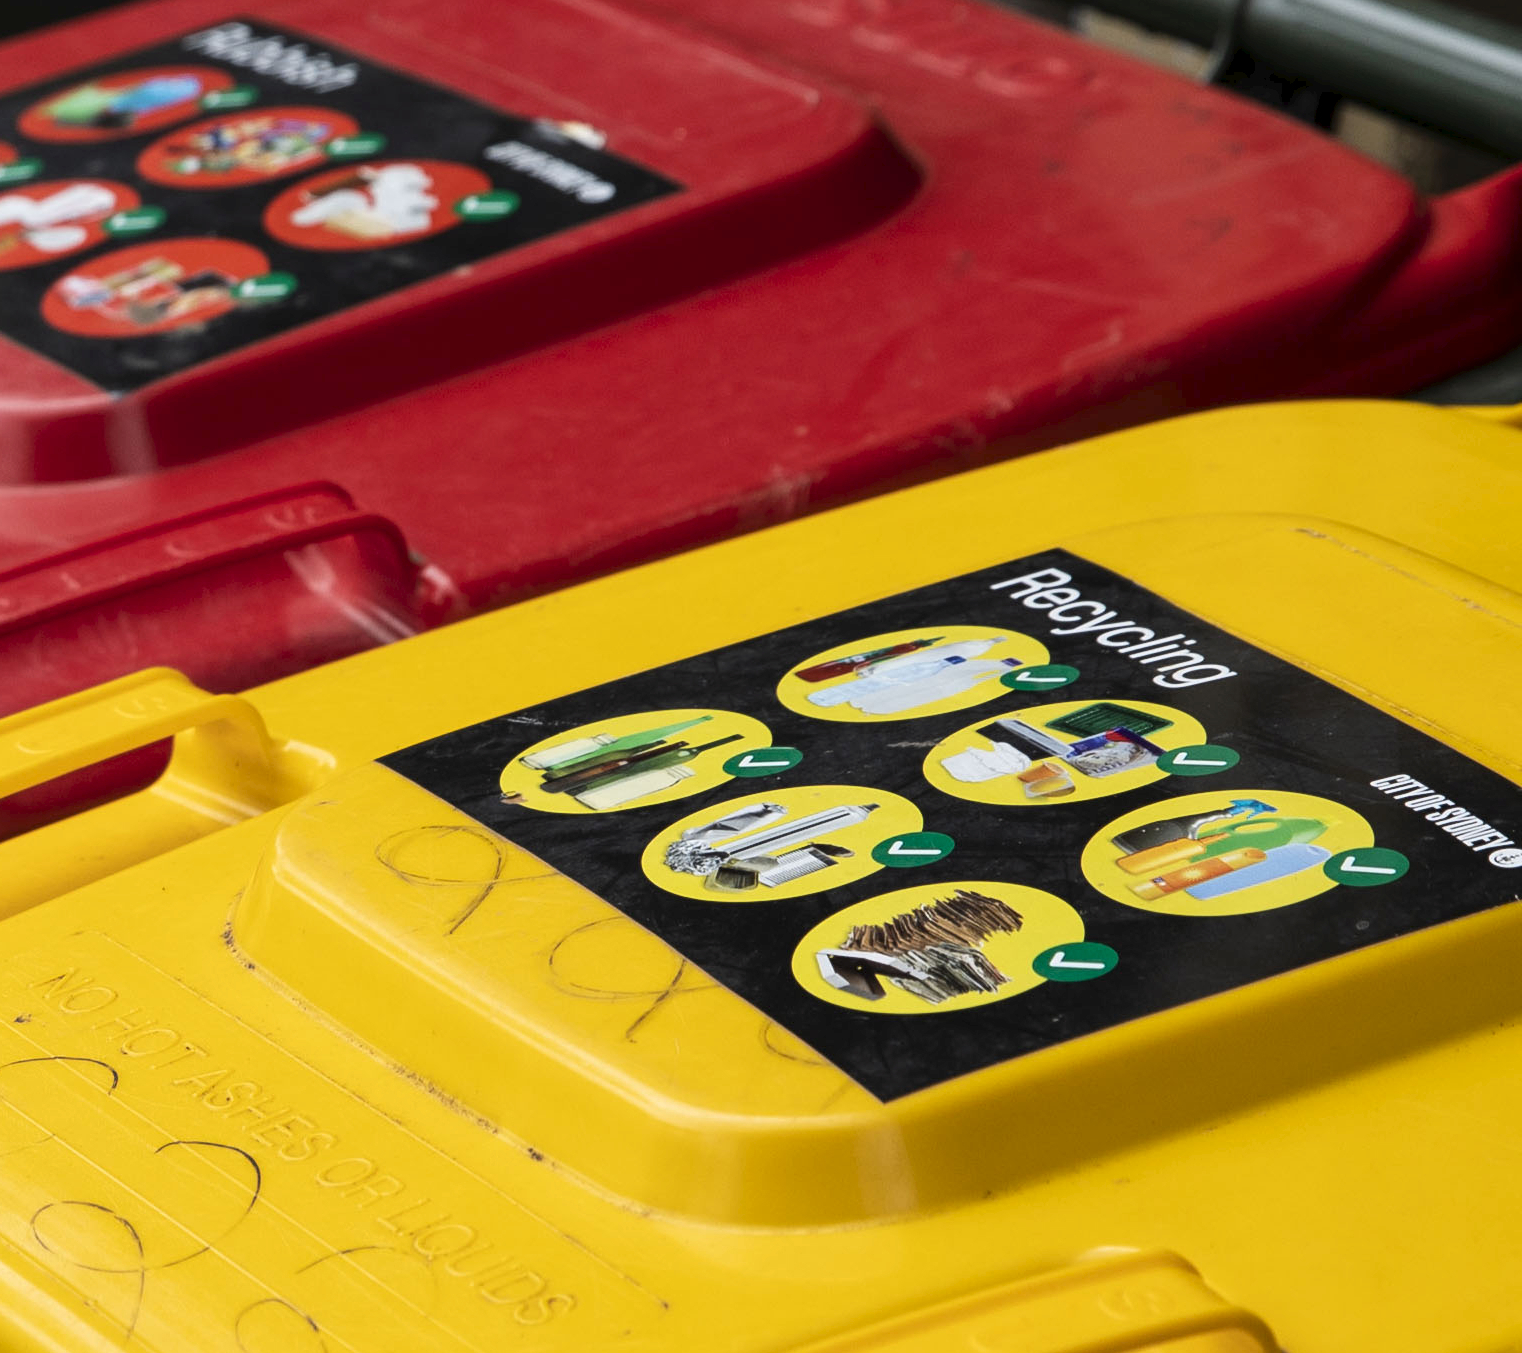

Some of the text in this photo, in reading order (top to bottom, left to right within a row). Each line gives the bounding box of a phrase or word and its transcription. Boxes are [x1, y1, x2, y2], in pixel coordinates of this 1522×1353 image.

[990, 567, 1238, 688] Recycling
[1370, 773, 1515, 852] CITY OF SYDNEY
[30, 967, 577, 1327] NO HOT ASHES OR LIQUIDS
